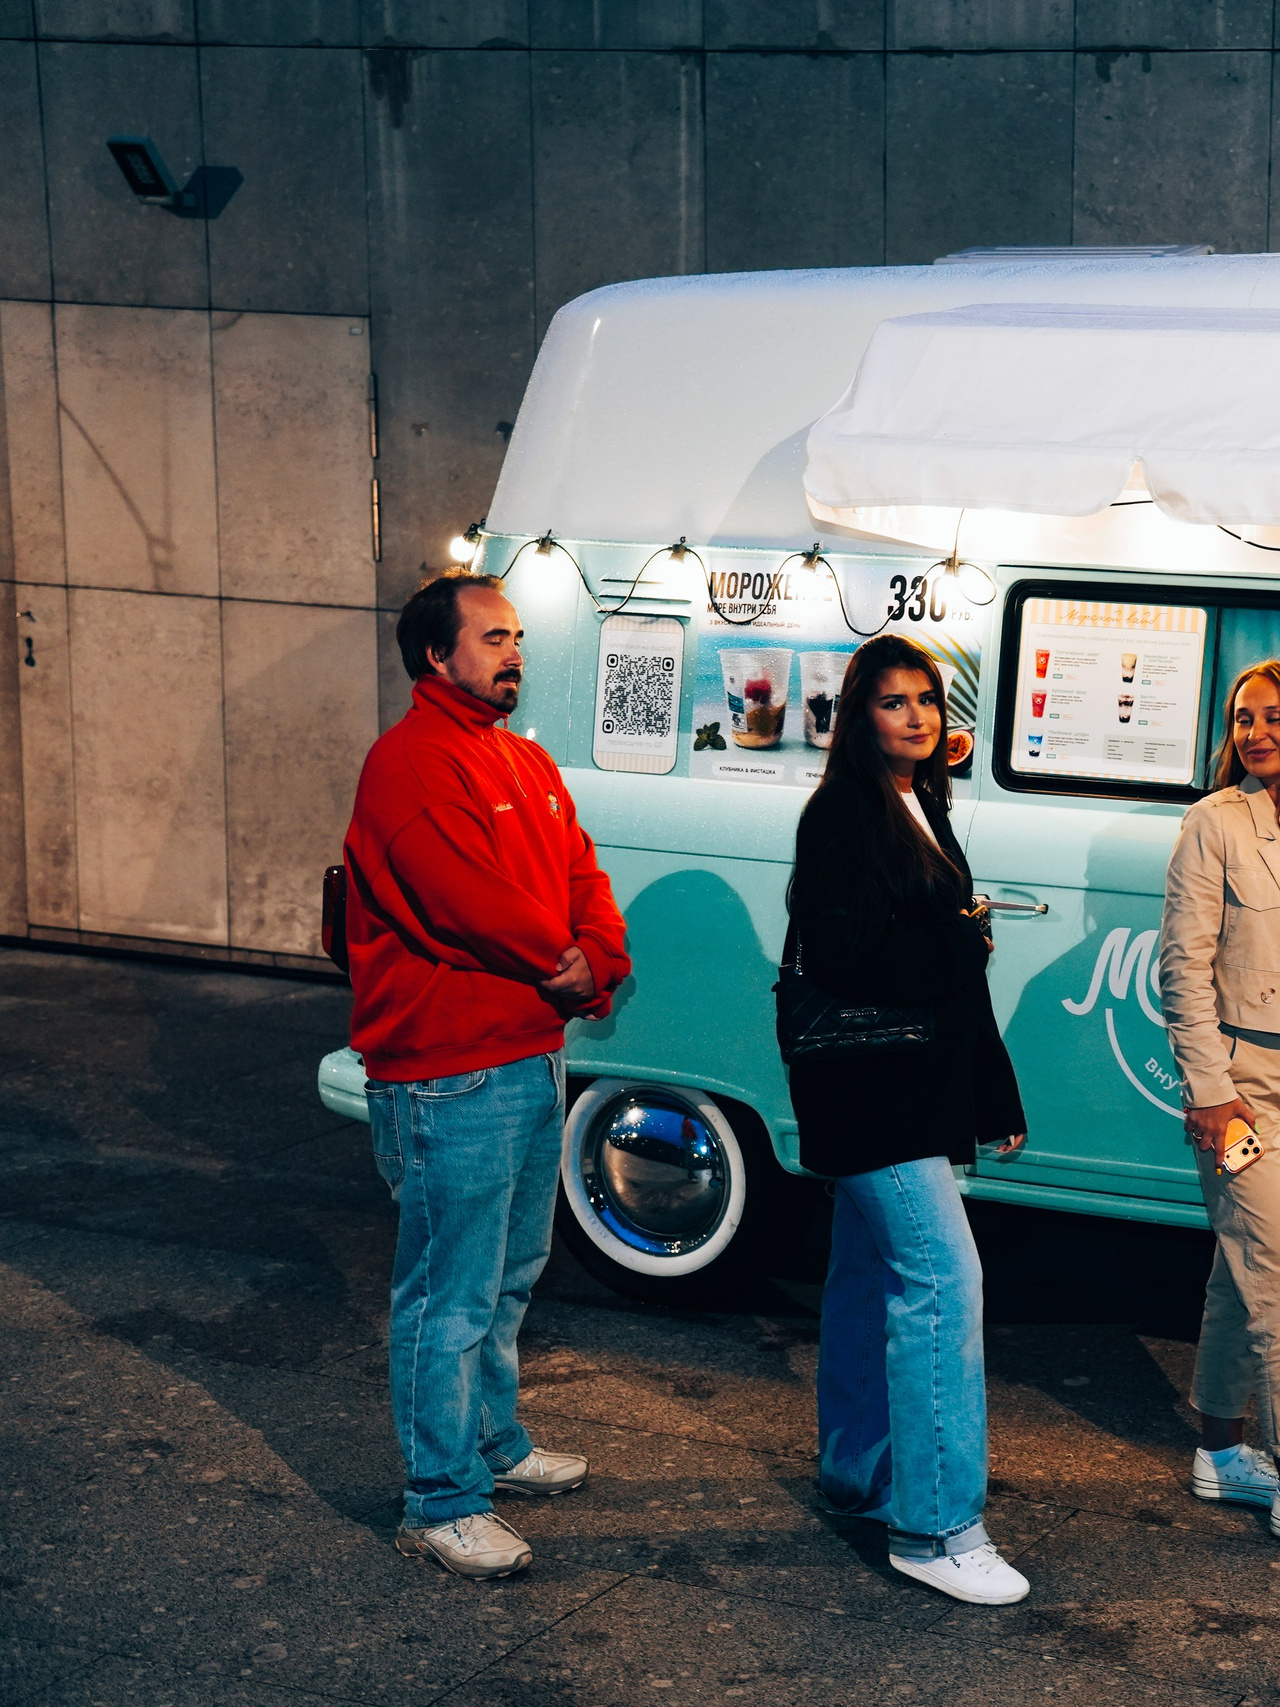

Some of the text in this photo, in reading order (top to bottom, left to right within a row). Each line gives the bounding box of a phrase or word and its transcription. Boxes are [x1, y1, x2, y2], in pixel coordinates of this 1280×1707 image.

[709, 571, 833, 601] МОРОЖЕ
[887, 574, 946, 622] 330
[728, 603, 757, 614] ВНУТРИ
[1144, 1057, 1183, 1096] ВНУ
